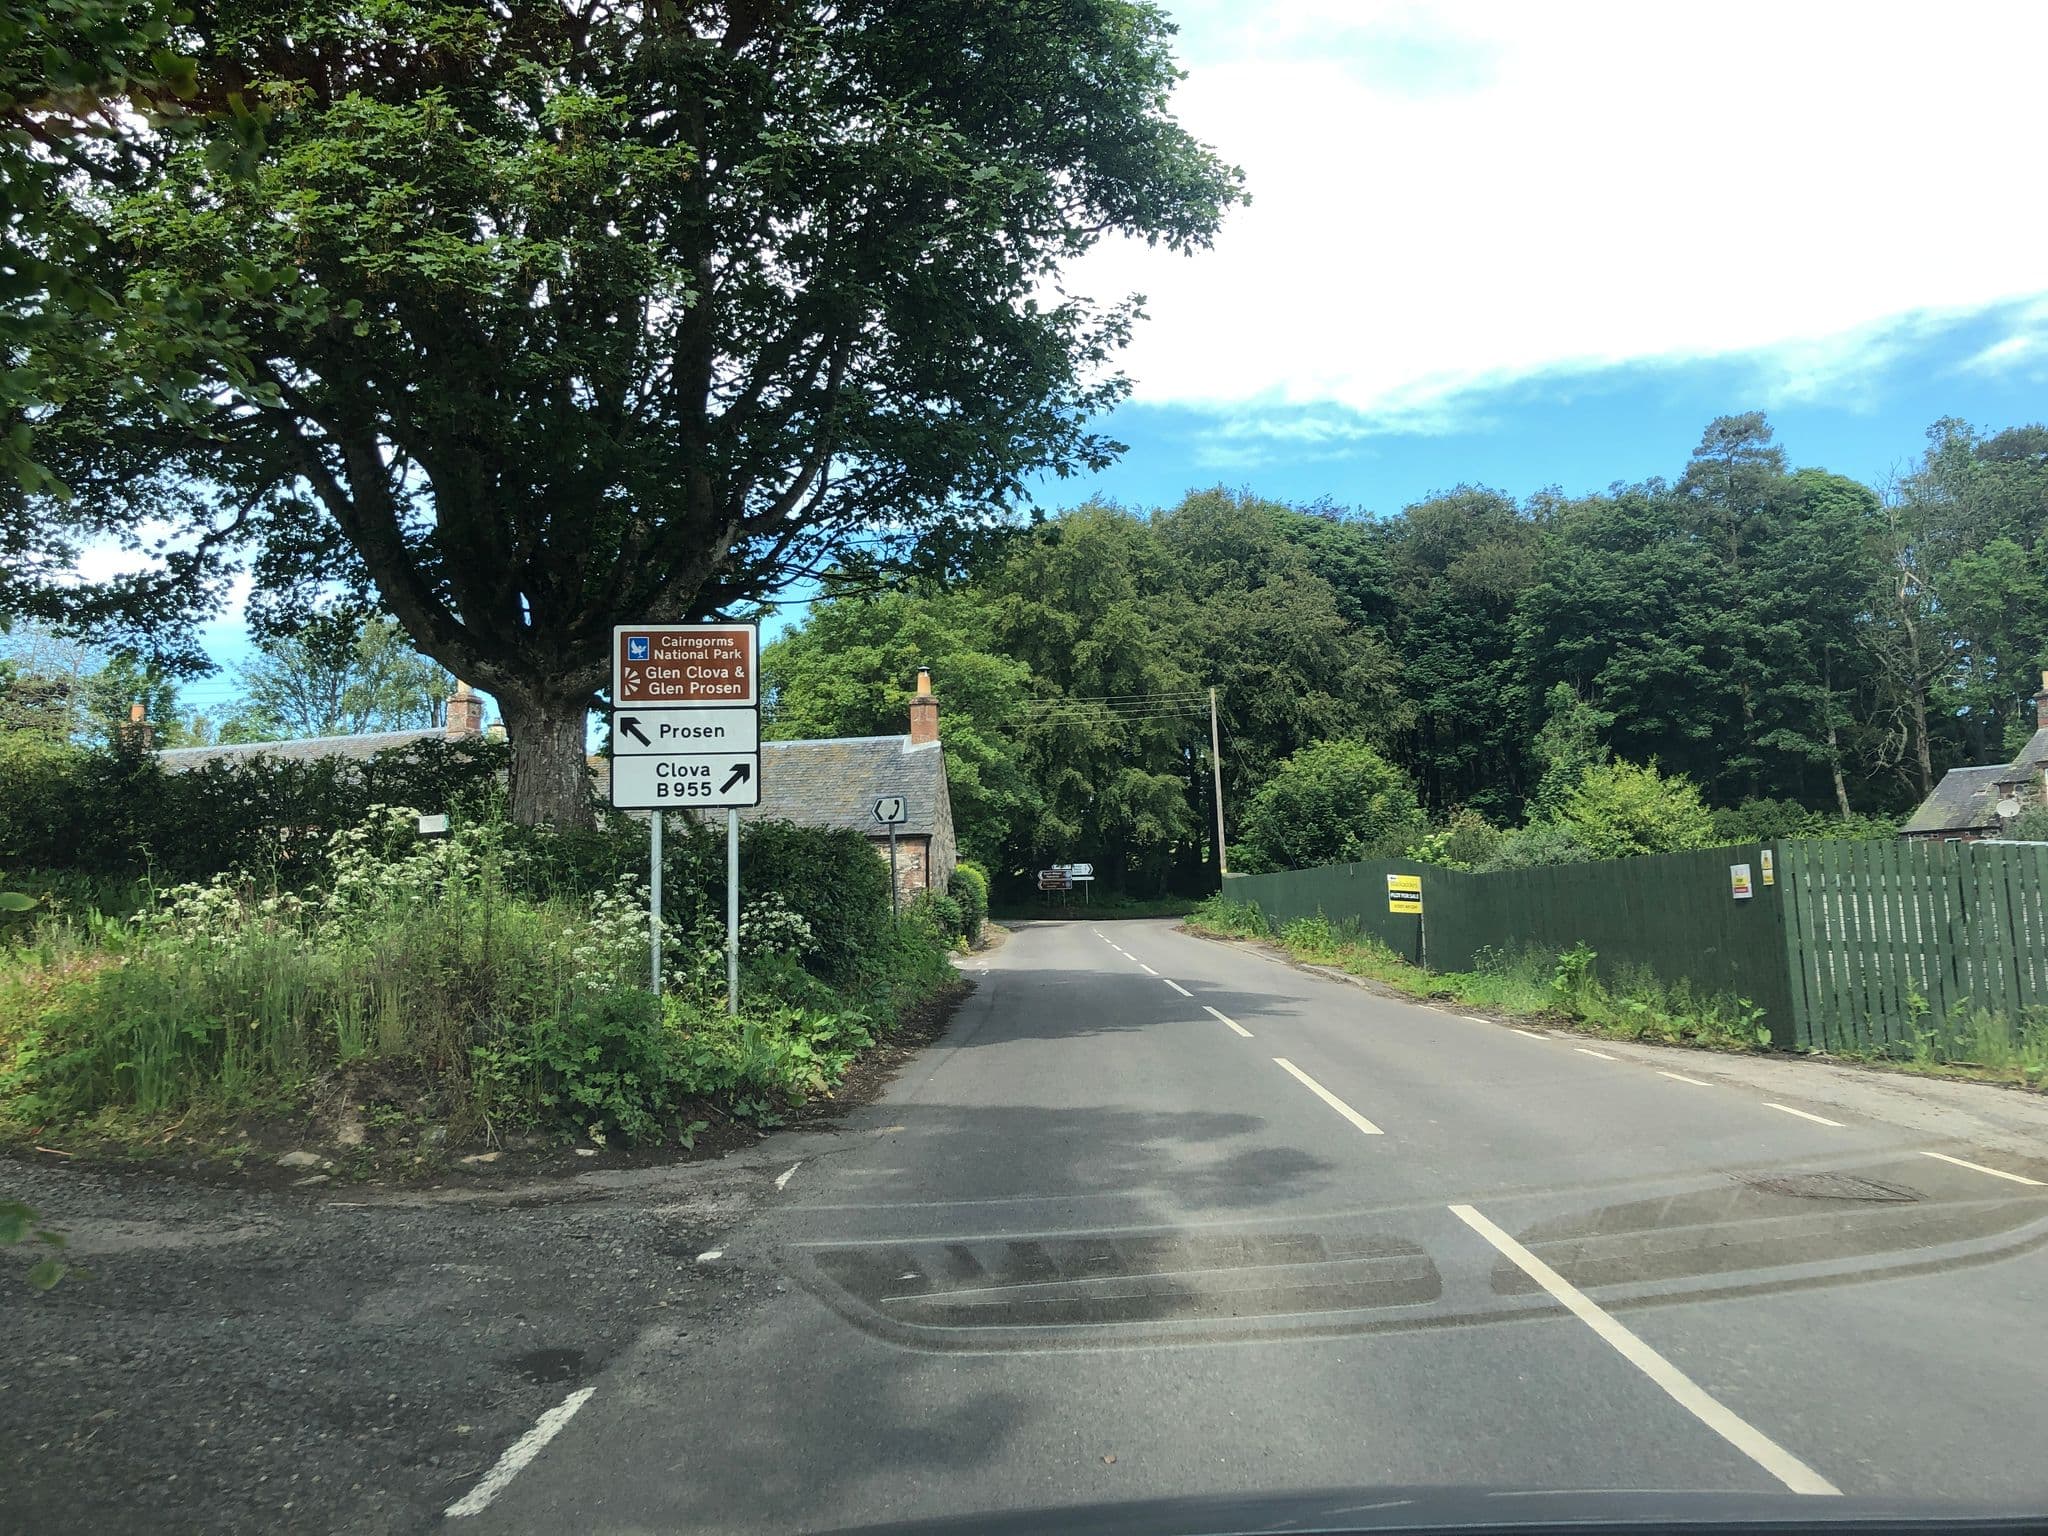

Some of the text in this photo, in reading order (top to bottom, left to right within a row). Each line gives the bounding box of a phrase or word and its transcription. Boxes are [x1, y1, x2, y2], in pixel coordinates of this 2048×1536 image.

[661, 636, 735, 649] Cairngorms
[654, 649, 742, 660] National Park
[645, 665, 745, 679] Glen Clova &
[649, 682, 742, 695] Glen Prosen
[660, 724, 725, 739] Prosen
[656, 762, 711, 777] Clova
